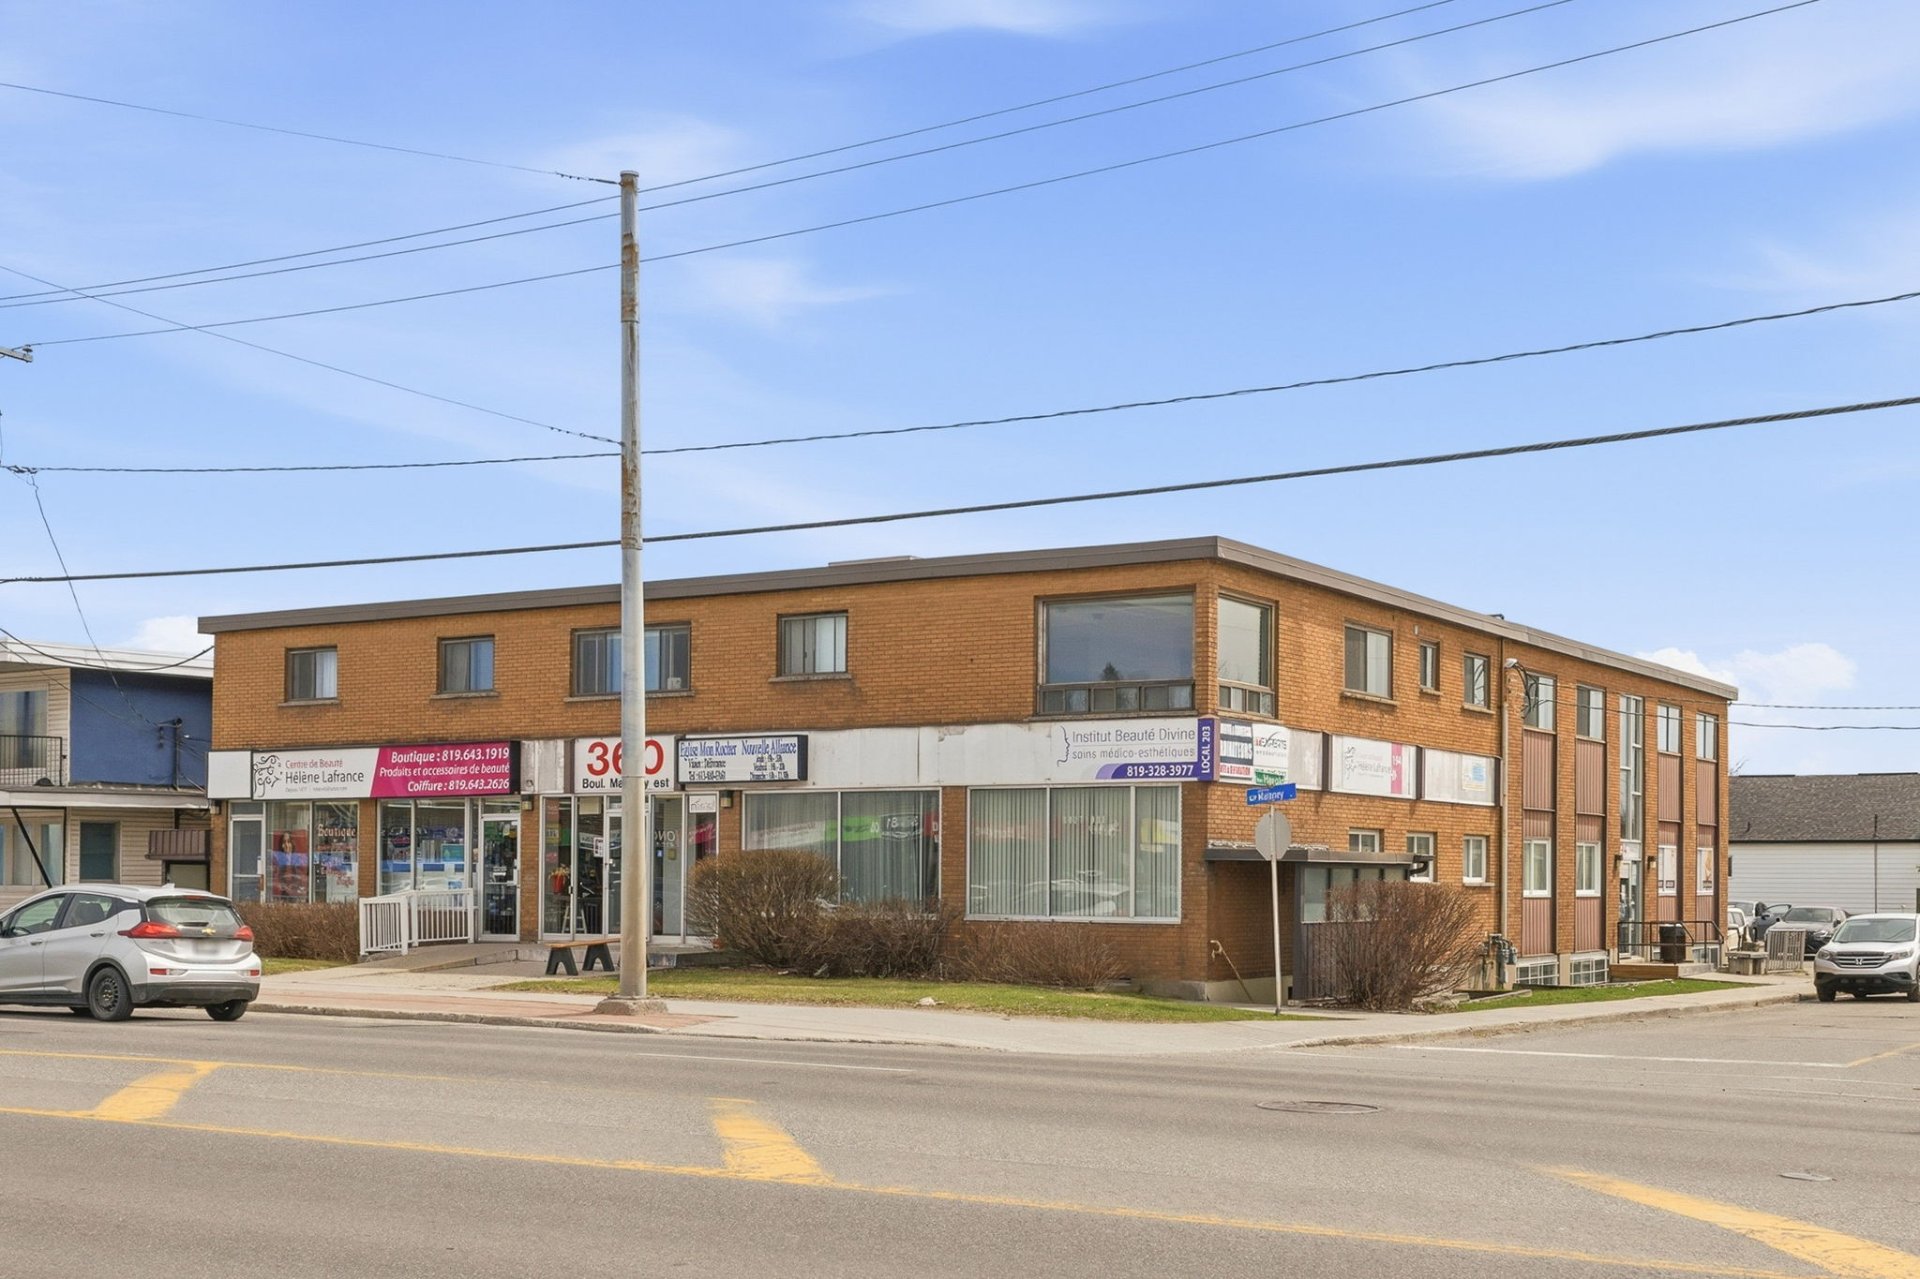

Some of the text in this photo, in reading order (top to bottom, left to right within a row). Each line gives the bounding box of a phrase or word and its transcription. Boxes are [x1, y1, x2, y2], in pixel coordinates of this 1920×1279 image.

[1072, 727, 1195, 743] Institut Beauté Divine
[391, 750, 435, 765] Boutique
[441, 747, 510, 761] 819.643.1919
[1072, 746, 1195, 760] soins médico-esthétiques
[1201, 726, 1211, 774] LOCAL 203
[285, 760, 308, 769] Centre
[319, 758, 343, 768] Beauté
[380, 762, 510, 777] Produits et accessoires de beauté
[1126, 764, 1194, 777] 819-328-3977
[285, 769, 364, 784] Hélène Lafrance
[582, 778, 606, 789] Boul.
[653, 778, 669, 788] est
[407, 780, 443, 792] Coiffure
[448, 778, 510, 791] 819.643.2626
[317, 823, 356, 841] Boutique
